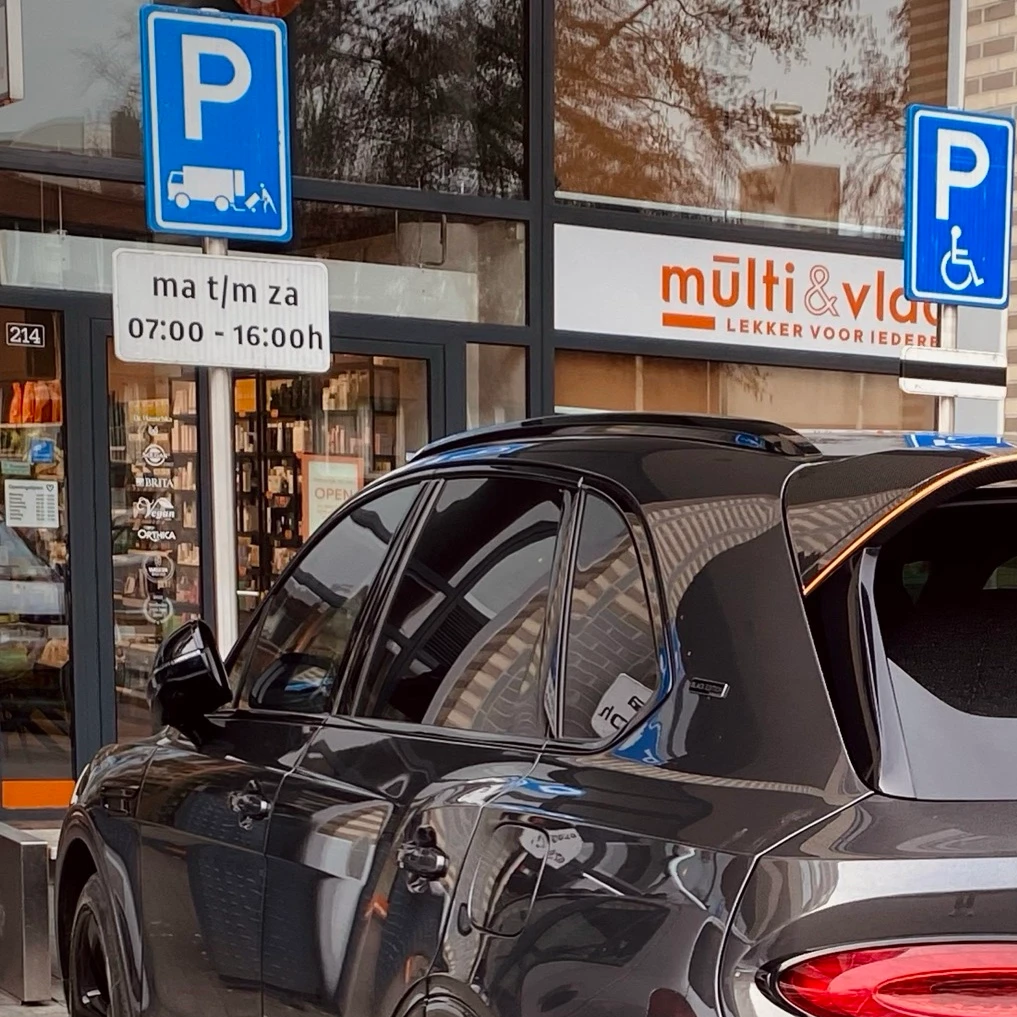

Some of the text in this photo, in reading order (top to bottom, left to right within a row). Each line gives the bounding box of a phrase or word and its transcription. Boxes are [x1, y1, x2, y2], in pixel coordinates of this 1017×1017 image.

[181, 33, 252, 141] P
[936, 128, 990, 220] P
[153, 275, 298, 309] ma t/m za
[10, 326, 41, 344] 214
[128, 317, 204, 342] 07:00
[233, 323, 323, 350] 16:00h
[727, 318, 803, 338] LEKKER
[810, 325, 864, 343] VOOR
[136, 497, 175, 519] Vegan
[314, 487, 353, 501] OPEN
